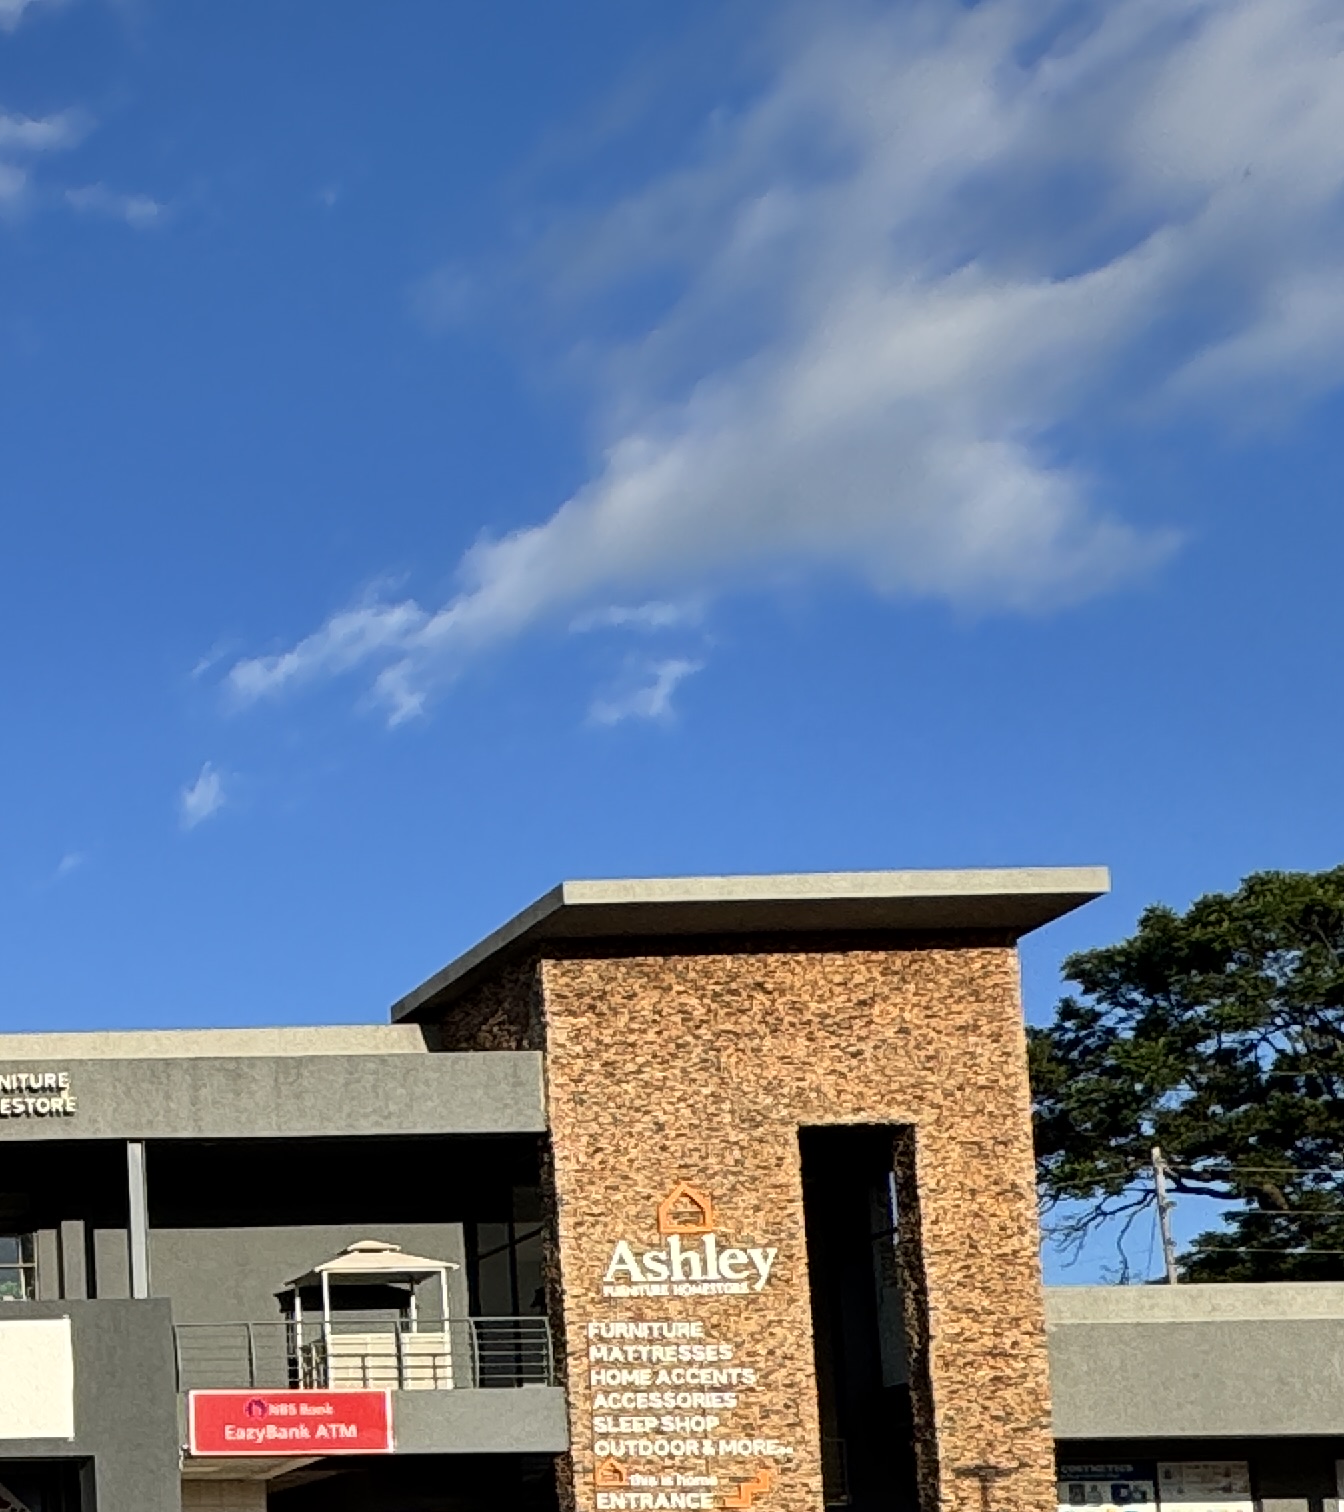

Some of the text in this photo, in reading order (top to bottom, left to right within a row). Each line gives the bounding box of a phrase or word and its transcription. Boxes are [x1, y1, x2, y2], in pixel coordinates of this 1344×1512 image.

[603, 1233, 777, 1291] Ashley
[588, 1322, 704, 1338] FURNITURE
[589, 1344, 733, 1362] MATTRESSES
[591, 1368, 756, 1386] HOME ACCENTS
[594, 1392, 738, 1409] ACCESSORIES
[300, 1403, 334, 1416] Bank
[593, 1415, 720, 1433] SLEEP SHOP
[223, 1424, 357, 1444] EazyBank ATM
[594, 1439, 700, 1456] OUTDOOR
[703, 1440, 716, 1455] &
[677, 1474, 718, 1486] home
[596, 1492, 714, 1509] ENTRANCE
